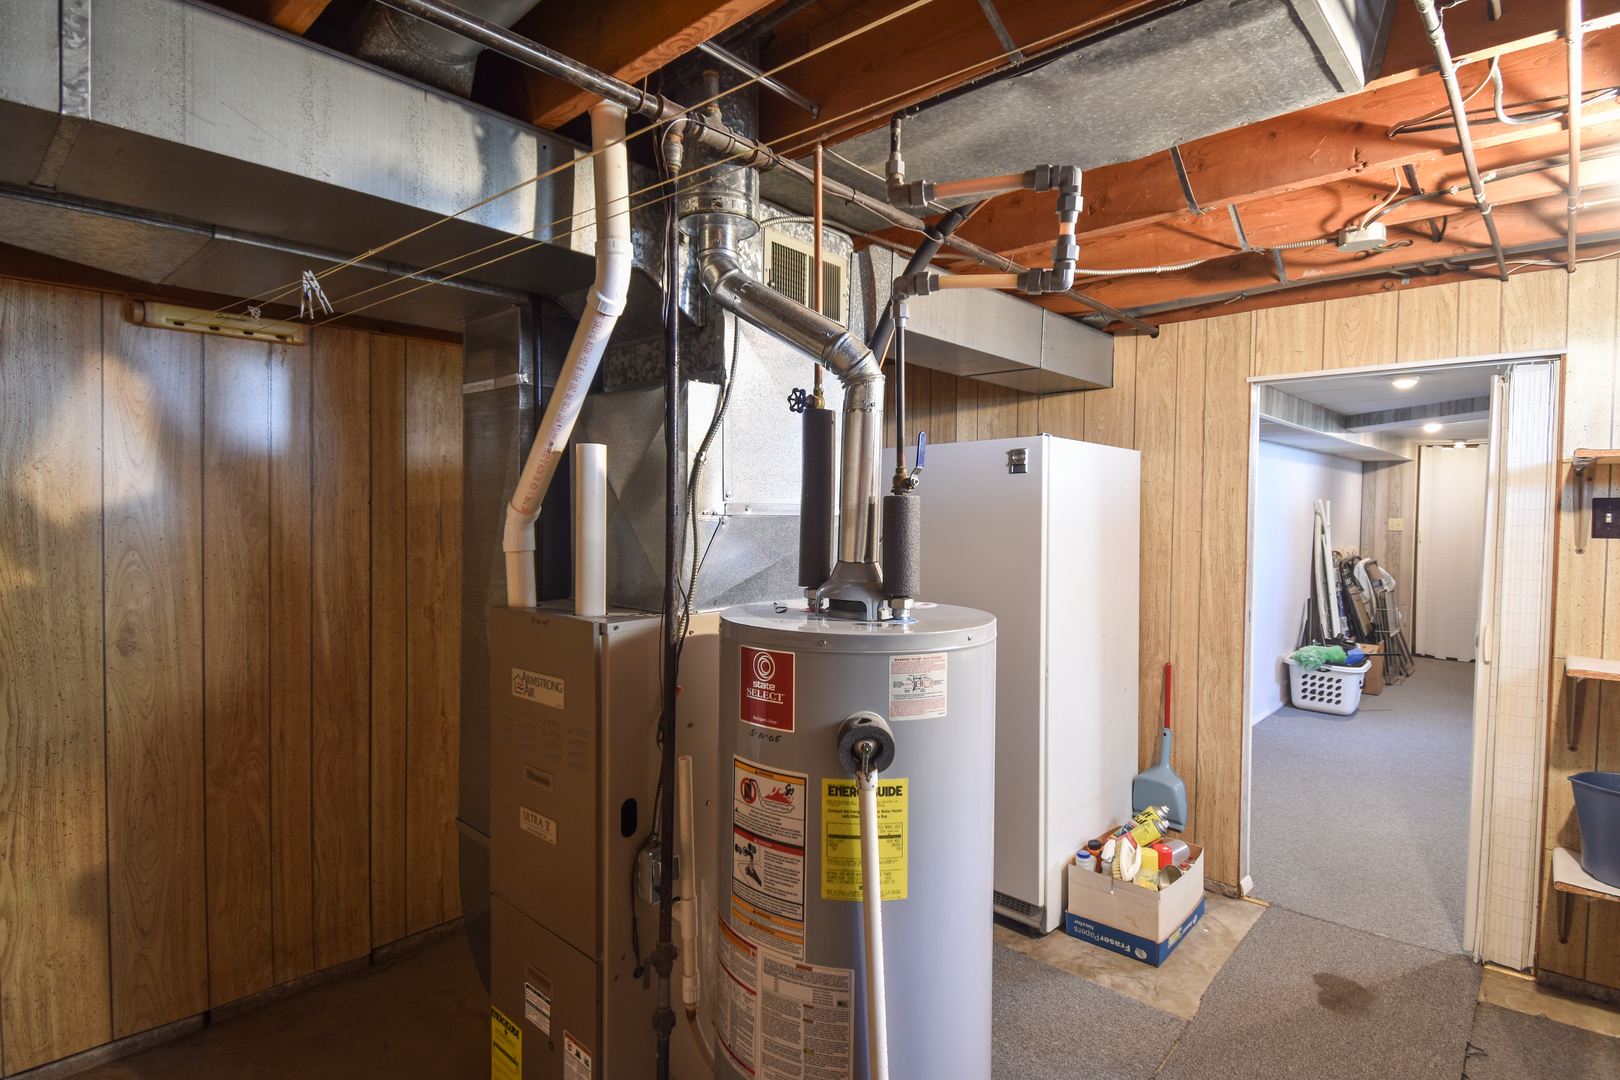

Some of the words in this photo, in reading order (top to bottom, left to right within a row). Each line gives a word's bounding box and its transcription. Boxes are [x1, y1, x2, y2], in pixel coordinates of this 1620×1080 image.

[583, 339, 594, 354] ASTM
[589, 320, 602, 340] D-1785
[752, 680, 776, 691] state
[746, 687, 784, 702] SELECT
[750, 728, 782, 743] 5-10-05
[523, 810, 544, 828] ULTRA
[1074, 920, 1094, 931] Nexfor
[1074, 926, 1131, 952] FraserPapers
